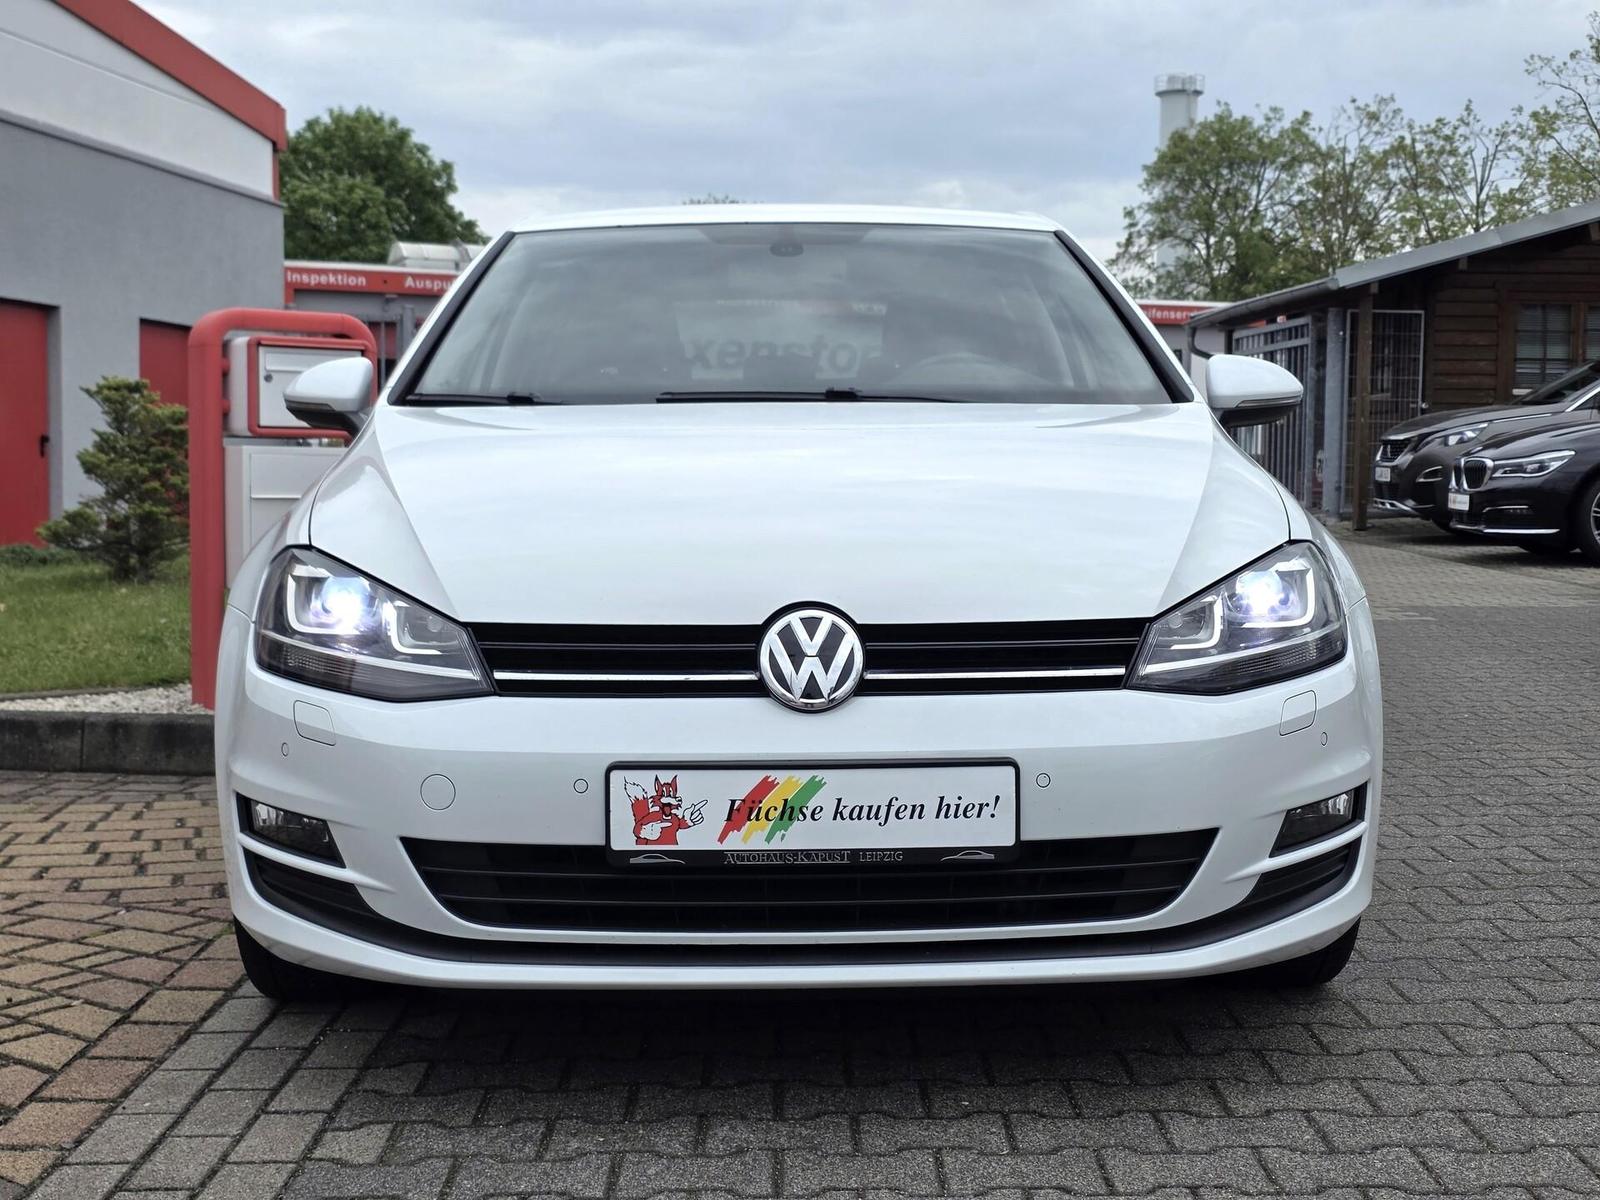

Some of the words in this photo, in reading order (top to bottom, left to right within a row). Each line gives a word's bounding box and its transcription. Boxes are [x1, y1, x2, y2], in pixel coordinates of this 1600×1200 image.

[287, 270, 367, 287] Inspektion
[404, 275, 456, 292] Auspu
[763, 612, 860, 704] VW
[724, 797, 824, 822] Füchse
[832, 796, 926, 827] kaufen
[935, 795, 1000, 819] hier!
[859, 851, 904, 862] LEIPZIG
